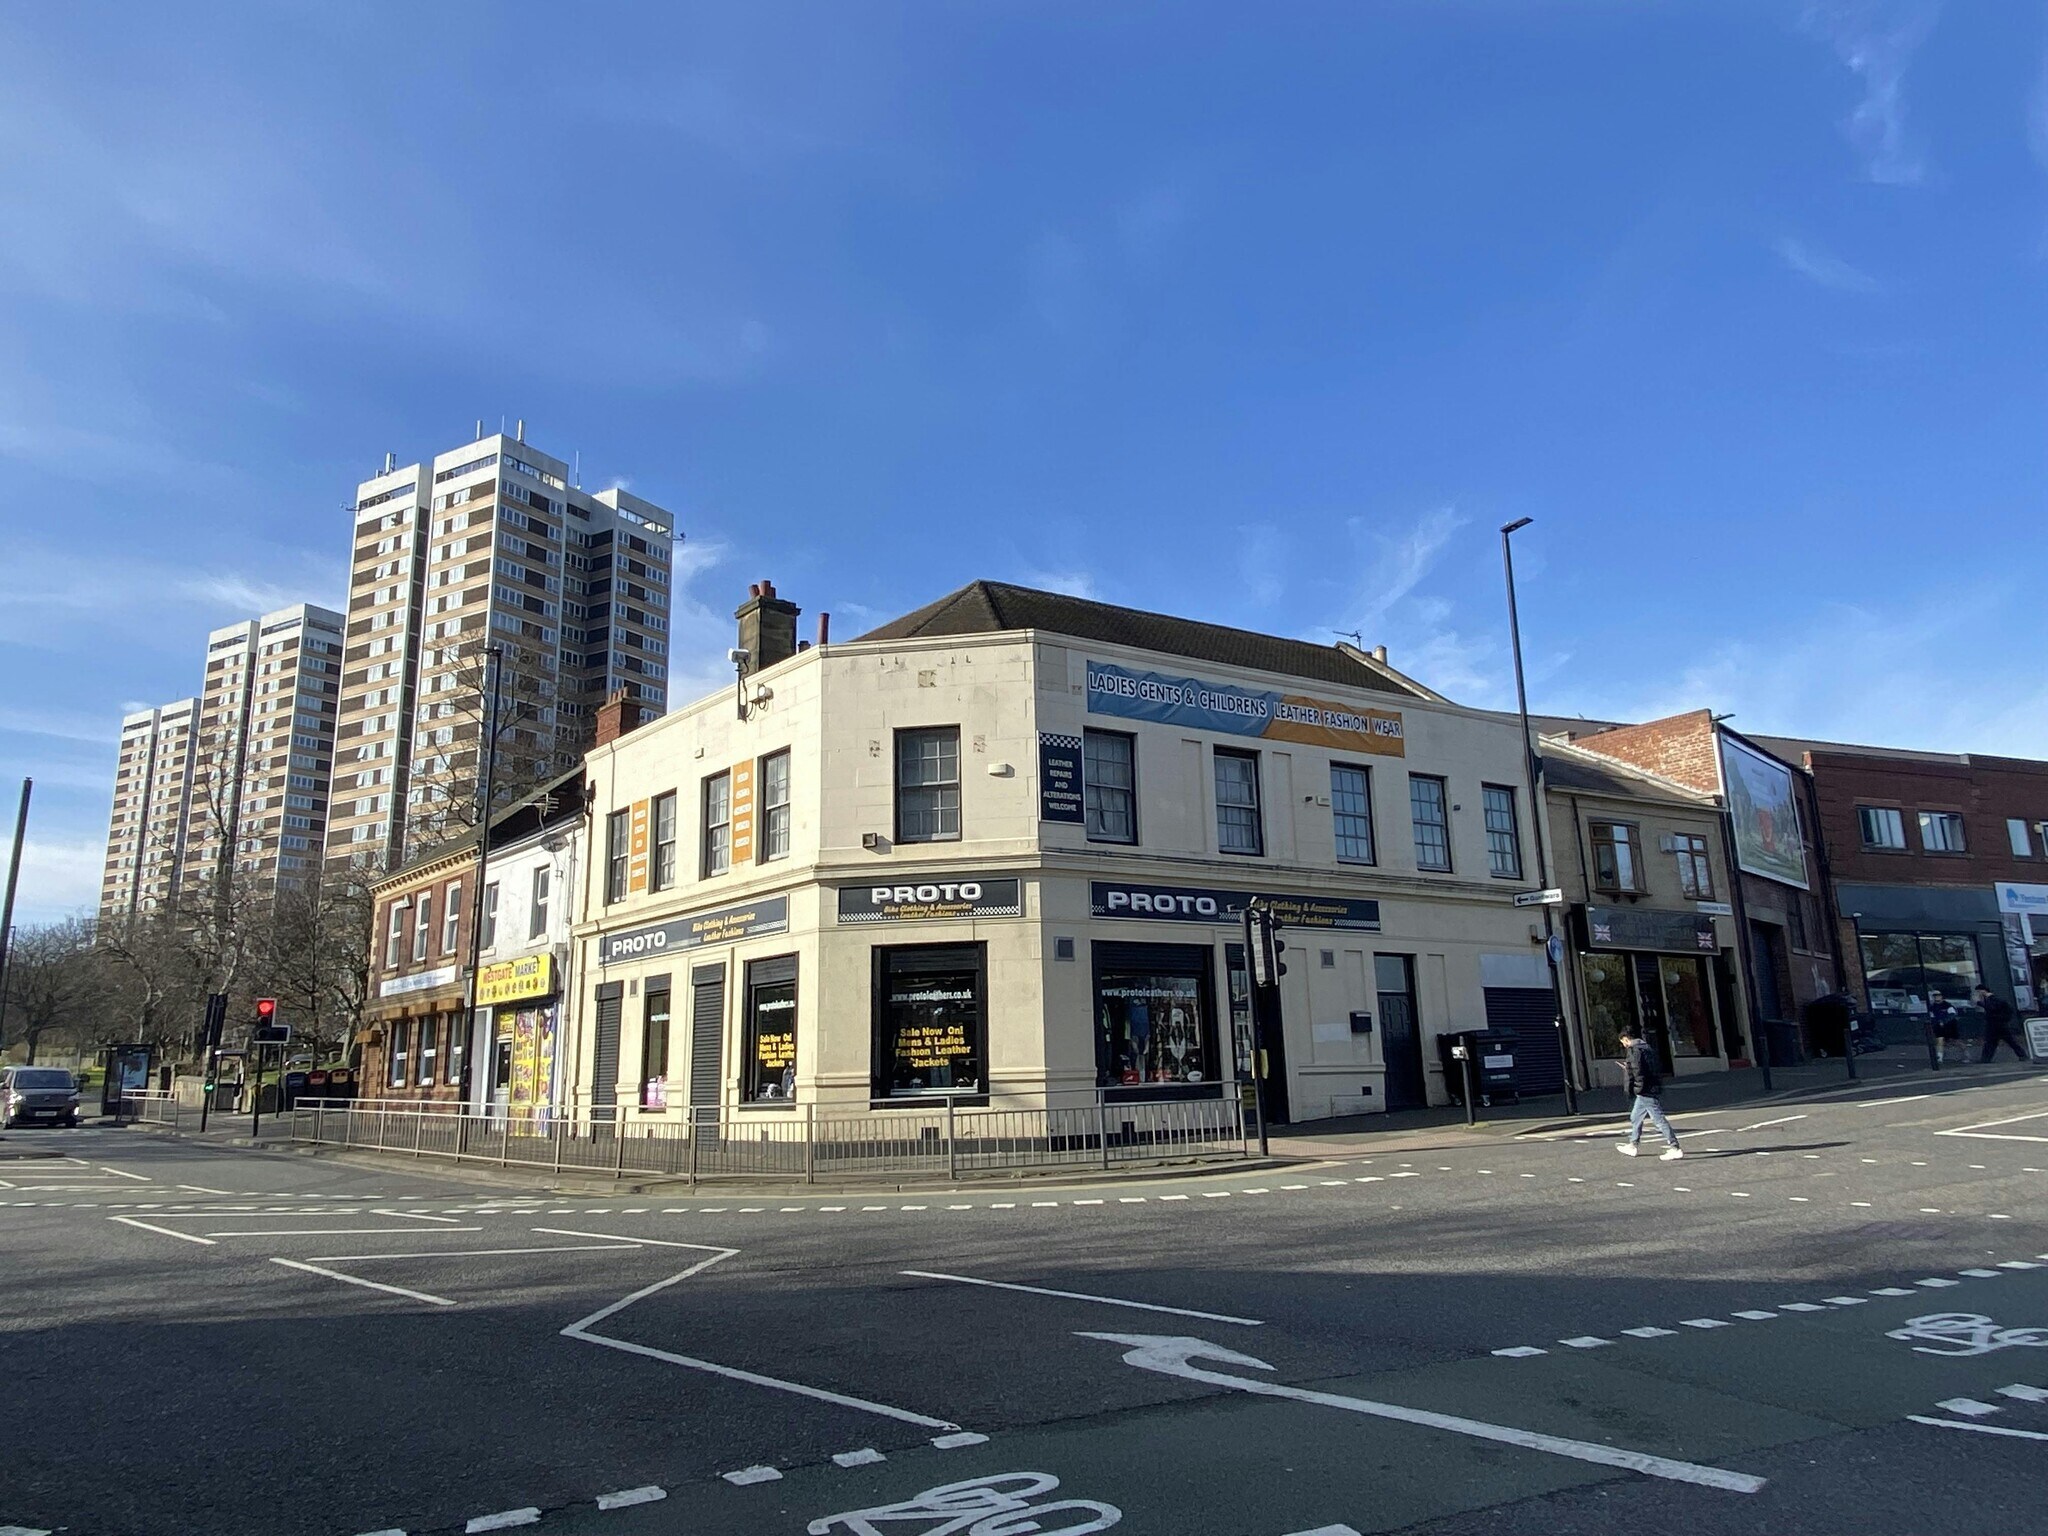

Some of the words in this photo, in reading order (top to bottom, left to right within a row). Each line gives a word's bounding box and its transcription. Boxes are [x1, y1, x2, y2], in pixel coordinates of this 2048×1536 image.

[1088, 672, 1136, 698] LADIES
[1138, 681, 1182, 705] GENTS
[1185, 688, 1196, 707] &
[1200, 690, 1267, 717] CHILDRENS
[1273, 702, 1322, 726] LEATHER
[1323, 711, 1369, 733] FASHION
[1373, 718, 1403, 738] WEAR
[1048, 758, 1073, 768] LEATHER
[1049, 769, 1072, 779] REPAIRS
[1054, 781, 1068, 789] AND
[1043, 791, 1081, 801] ALTERATIONS
[1048, 802, 1077, 812] WELCOME
[872, 883, 983, 904] PROTO
[900, 904, 928, 912] Clothing
[1108, 891, 1218, 915] PROTO
[612, 931, 666, 956] PROTO
[515, 961, 539, 977] MARKET
[900, 1027, 920, 1037] Sale
[922, 1026, 943, 1036] Now
[947, 1025, 964, 1035] On!
[924, 1037, 931, 1046] &
[934, 1035, 965, 1045] Ladies
[895, 1047, 931, 1057] Fashion
[935, 1045, 971, 1055] Leather
[912, 1057, 949, 1067] Jackets
